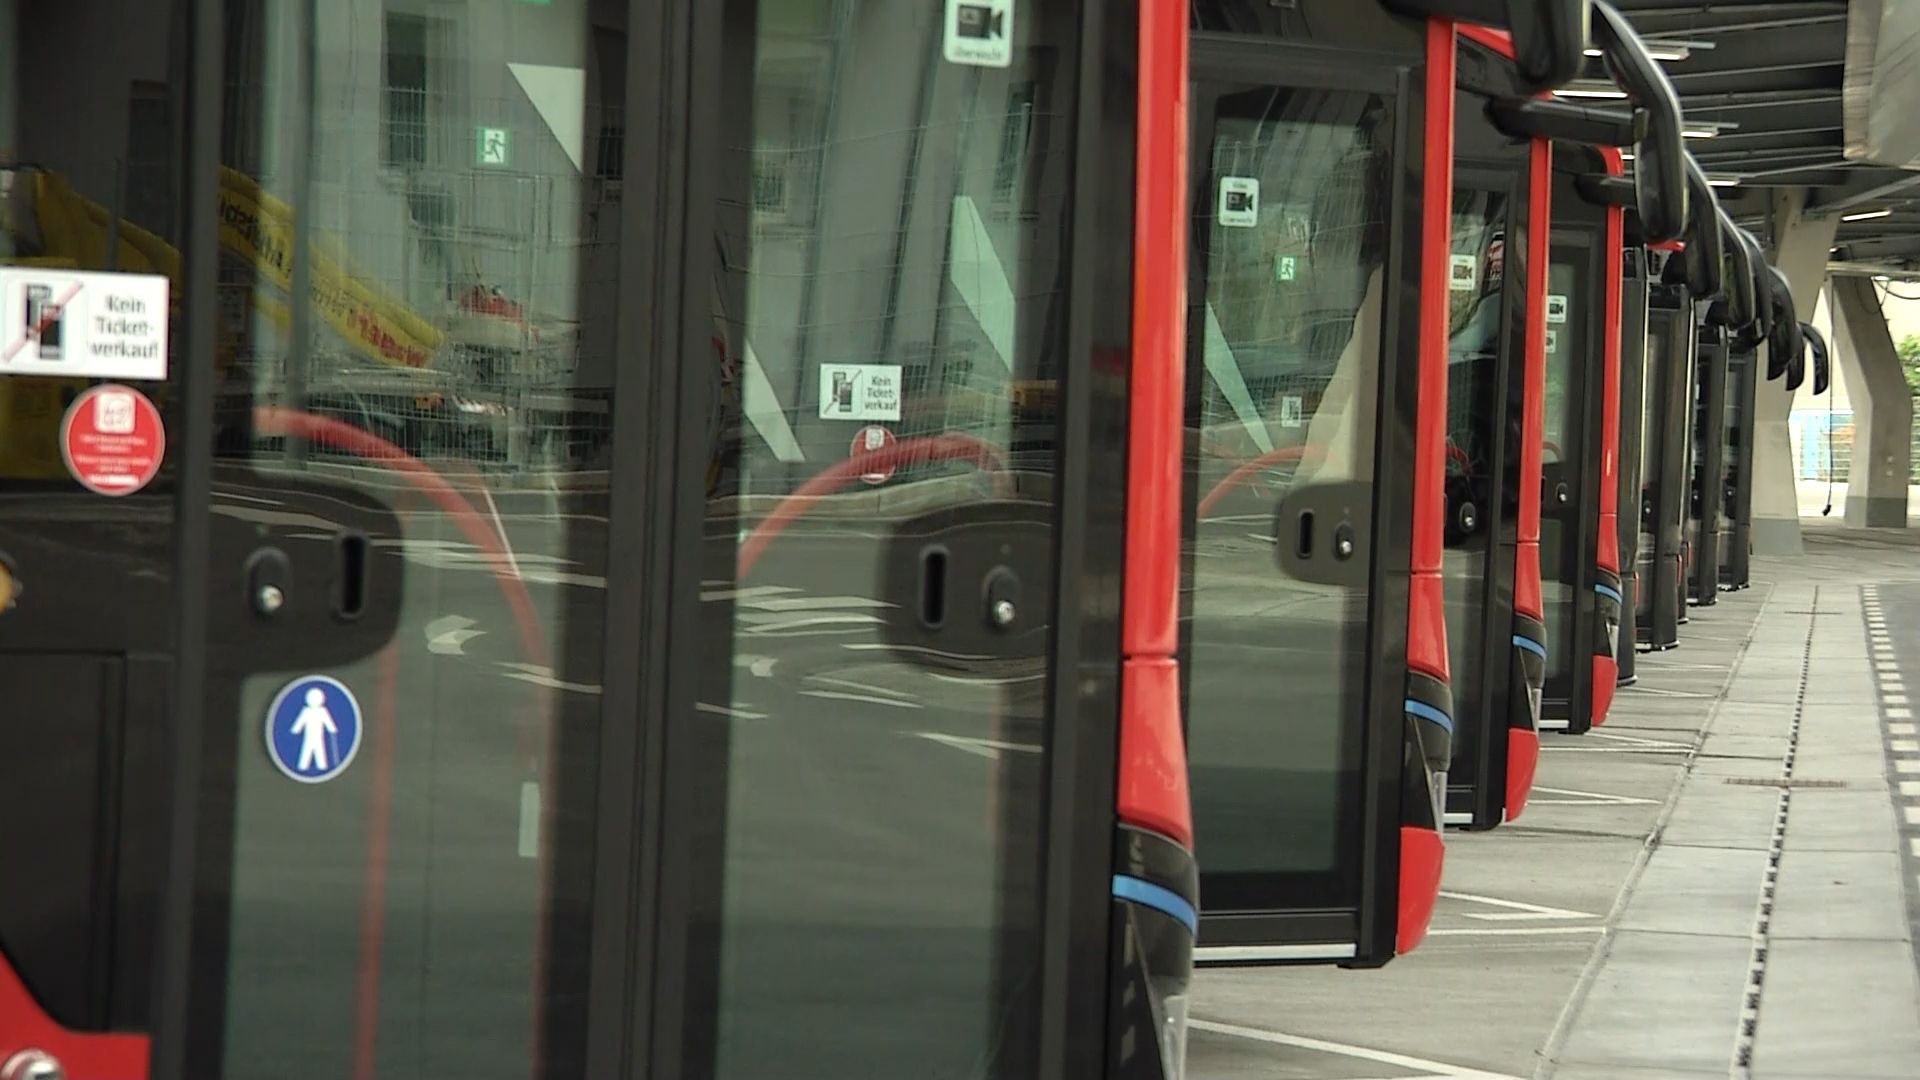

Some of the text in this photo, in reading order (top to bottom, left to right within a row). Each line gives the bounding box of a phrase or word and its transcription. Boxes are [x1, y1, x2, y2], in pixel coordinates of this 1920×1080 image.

[105, 294, 146, 313] Kein
[90, 340, 159, 360] verkauf
[871, 375, 892, 386] Kein
[864, 400, 898, 411] verkauf
